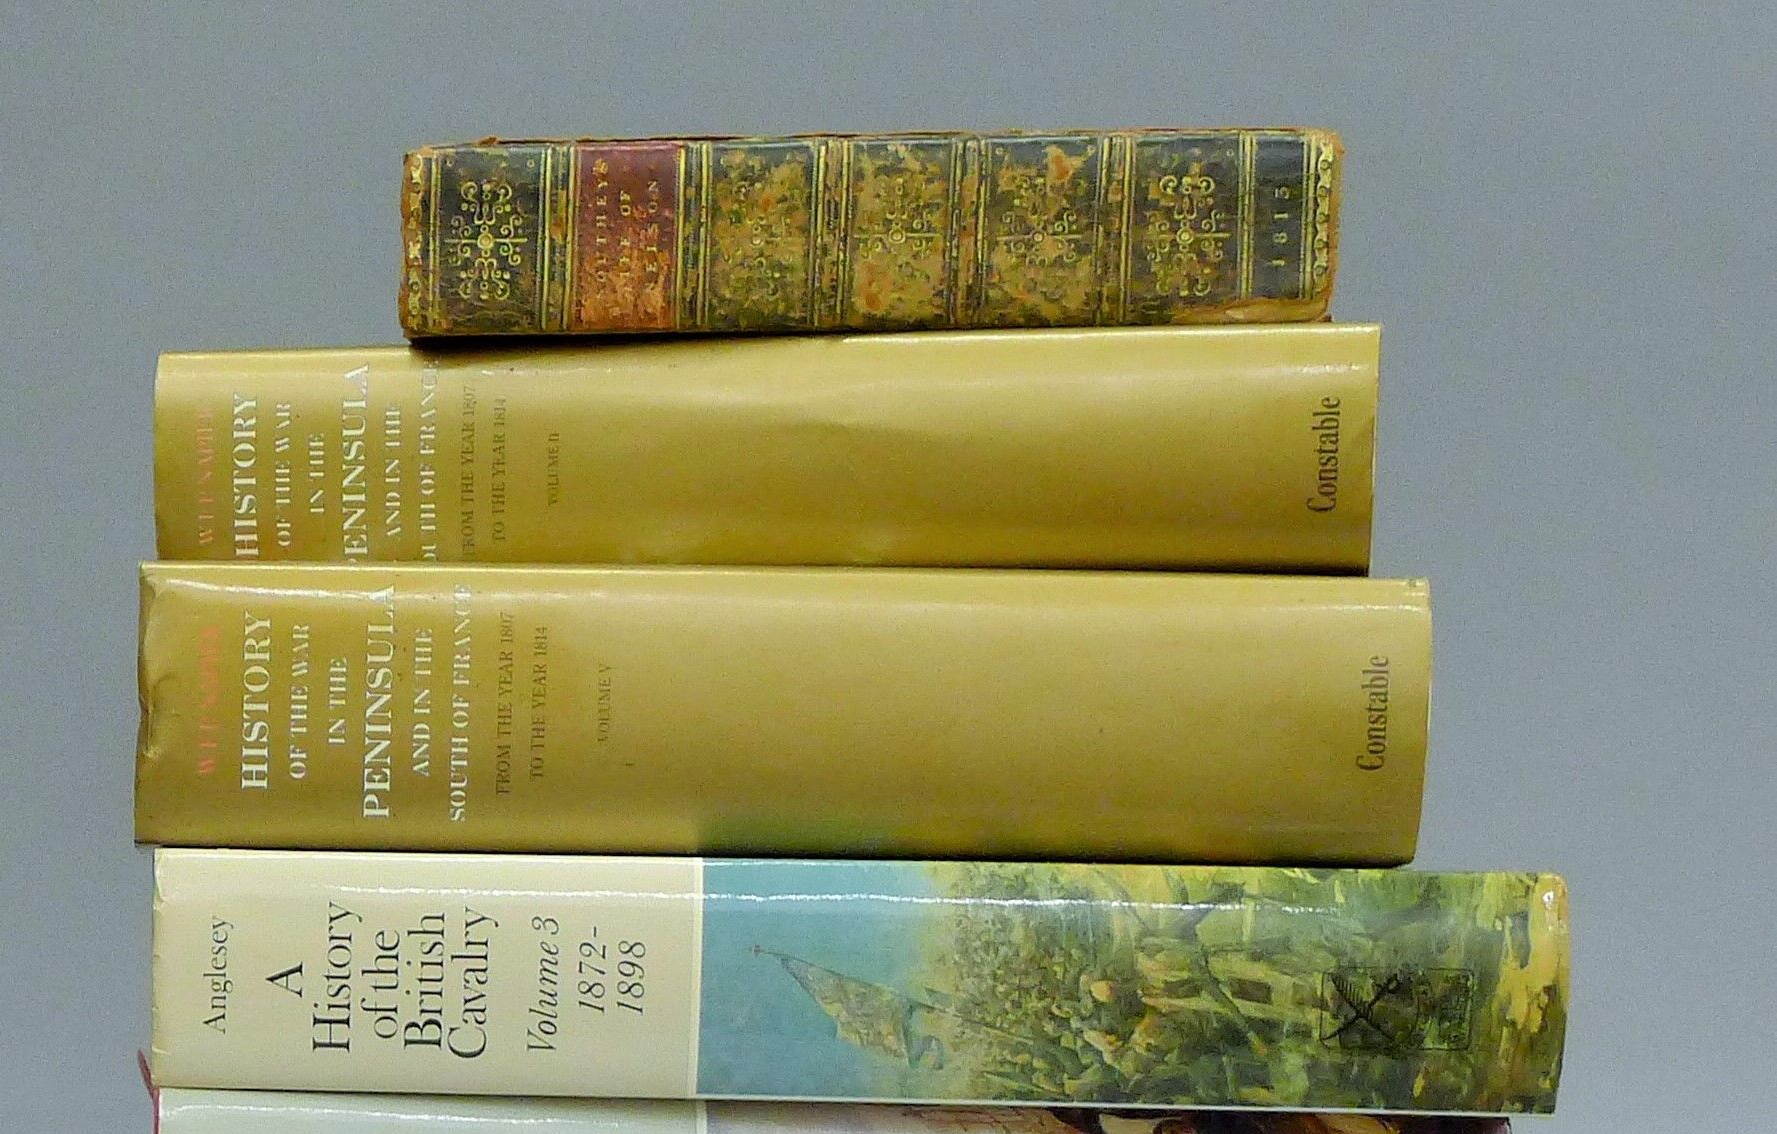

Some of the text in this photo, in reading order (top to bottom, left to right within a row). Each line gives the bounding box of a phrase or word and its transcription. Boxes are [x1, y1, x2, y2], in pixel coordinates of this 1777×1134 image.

[232, 392, 260, 557] HISTORY
[1306, 395, 1341, 514] Constable
[241, 610, 272, 790] HISTORY
[289, 623, 310, 780] OF THE WAR
[328, 656, 348, 745] IN THE
[363, 583, 396, 818] PENINSULA
[412, 627, 433, 777] AND IN THE
[449, 583, 472, 822] SOUTH OF FRANCE
[1356, 655, 1390, 773] Constable
[202, 915, 236, 1035] Anglesey
[265, 960, 304, 998] A
[312, 901, 363, 1053] History
[360, 929, 402, 1039] of the
[403, 911, 446, 1050] British
[447, 905, 499, 1060] Cavalry
[526, 915, 560, 1053] Volume 3
[576, 925, 608, 1014] 1872-
[616, 939, 647, 1014] 1898
